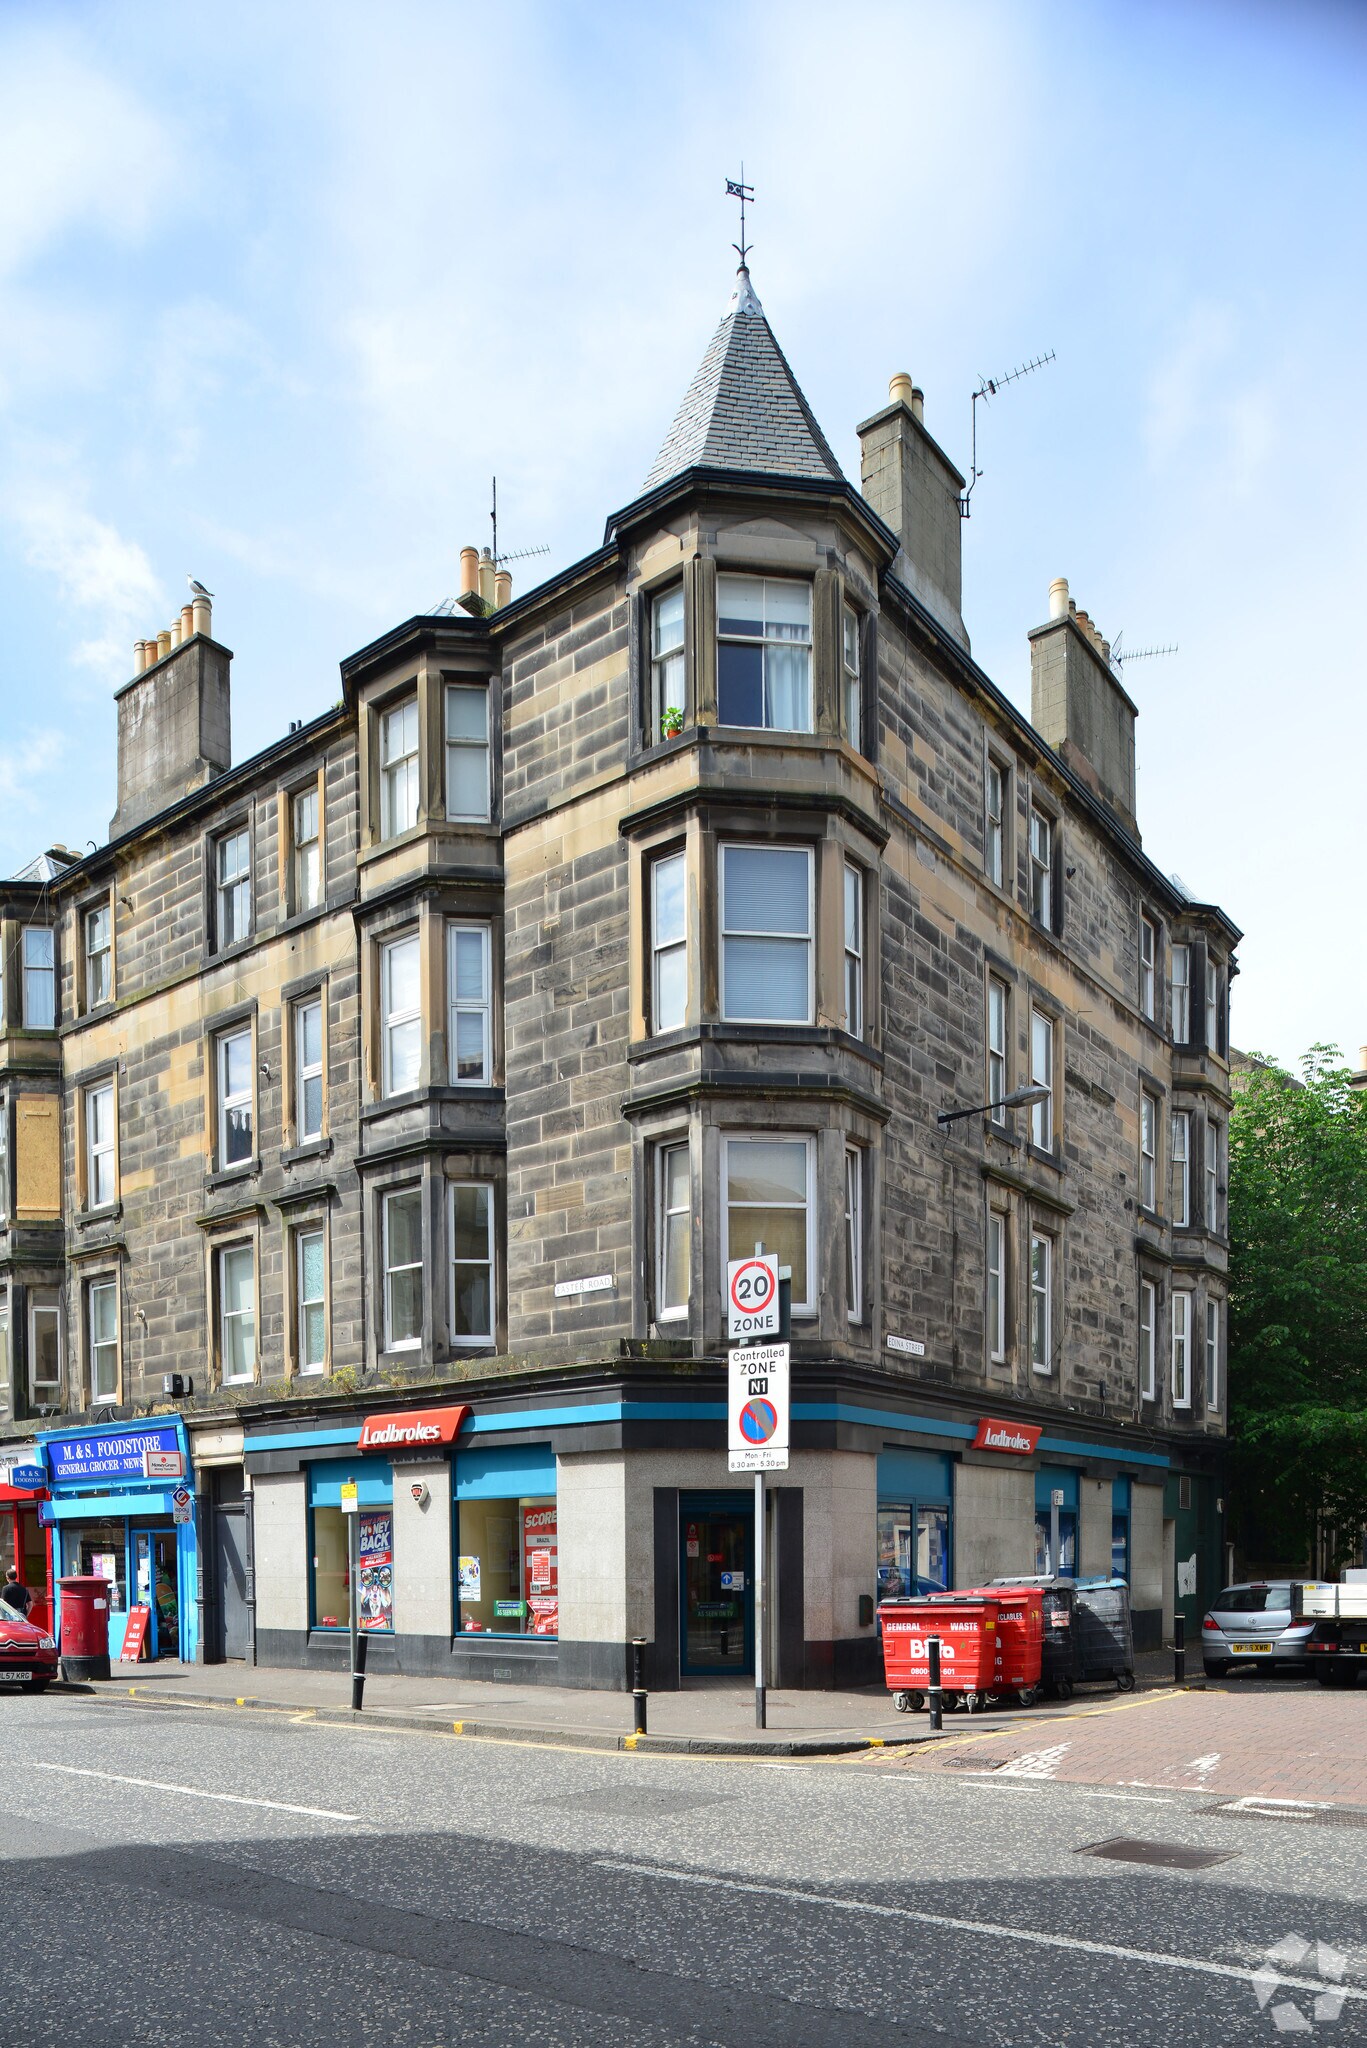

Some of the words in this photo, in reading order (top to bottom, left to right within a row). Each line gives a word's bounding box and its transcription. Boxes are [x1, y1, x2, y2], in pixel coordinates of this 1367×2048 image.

[556, 1281, 585, 1294] EASTER
[588, 1277, 611, 1289] ROAD
[738, 1275, 769, 1300] 20
[733, 1314, 774, 1332] ZONE
[732, 1347, 785, 1361] Controlled
[888, 1337, 904, 1348] EDINA
[905, 1341, 924, 1354] STREET
[739, 1360, 777, 1376] ZONE
[750, 1380, 766, 1394] N1
[362, 1421, 440, 1445] Ladbrokes
[983, 1427, 1031, 1451] Ladbrokes
[62, 1445, 75, 1461] M.
[75, 1443, 84, 1460] &
[85, 1443, 94, 1459] S.
[96, 1435, 161, 1457] FOODSTORE
[57, 1462, 89, 1476] GENERAL
[89, 1459, 119, 1473] GROCER
[730, 1461, 745, 1469] 8.30
[525, 1510, 557, 1529] SCORE
[360, 1520, 390, 1538] MONEY
[360, 1531, 391, 1552] BACK
[706, 1609, 718, 1617] SEEN
[718, 1609, 726, 1617] ON
[726, 1609, 734, 1617] TV
[886, 1622, 921, 1631] GENERAL
[950, 1622, 978, 1631] WASTE
[1254, 1643, 1269, 1651] XWR
[15, 1672, 30, 1680] KRG
